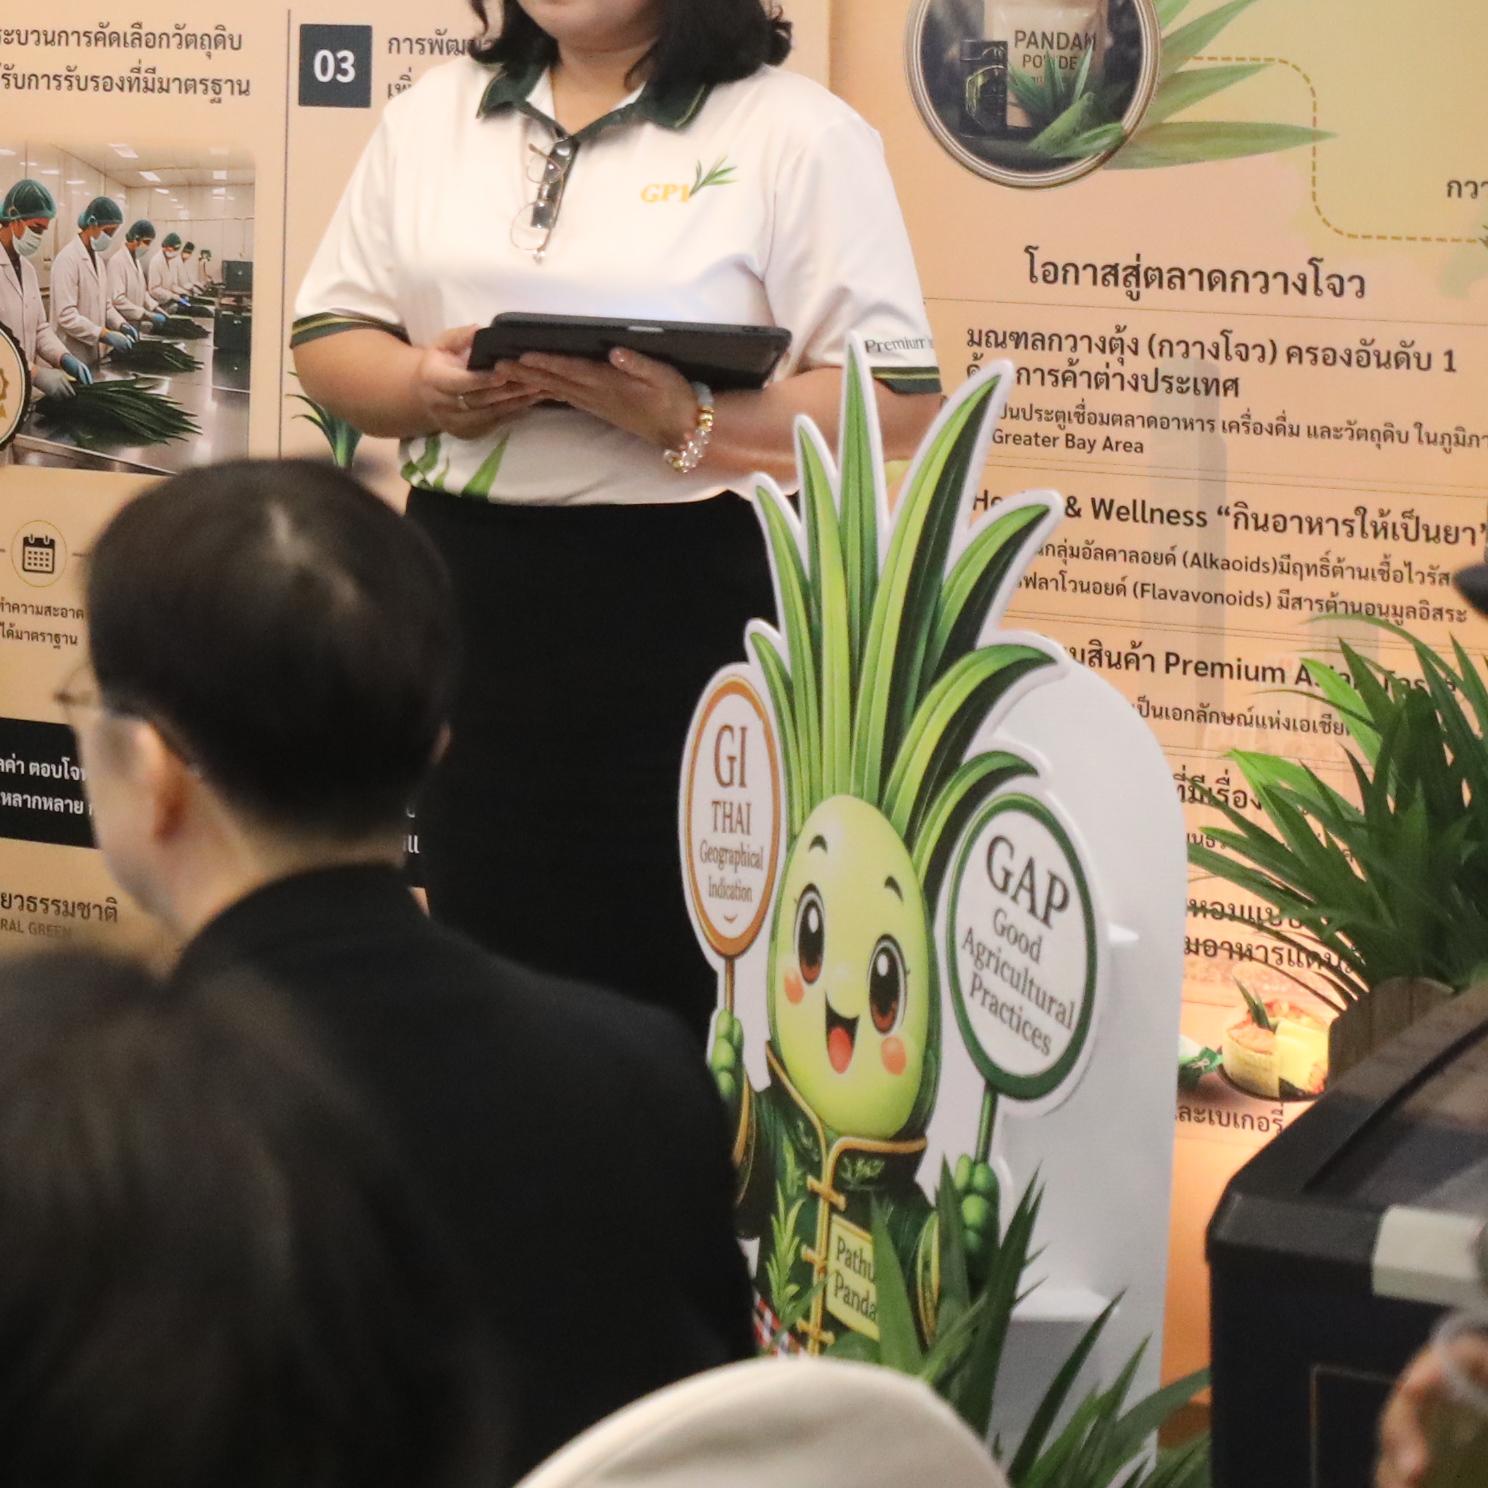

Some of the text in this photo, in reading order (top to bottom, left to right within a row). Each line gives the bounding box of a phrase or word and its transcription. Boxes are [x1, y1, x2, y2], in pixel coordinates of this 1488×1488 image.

[313, 49, 356, 83] 03
[640, 183, 691, 203] GP1
[1023, 244, 1366, 302] โอกาสสู่ตลาดกวางโจว
[966, 324, 1457, 373] มณฑลกวางตุ้ง (กวางโจว) ครองอันดับ 1
[991, 427, 1144, 454] Greater Bay Area
[1221, 407, 1301, 438] เครื่องดื่ม
[1306, 419, 1410, 450] และวัตถุดิบ
[1090, 497, 1208, 528] Wellness
[1017, 571, 1128, 599] ฟลาโวนอยด์
[1132, 580, 1272, 610] (Flavavonoids)
[1164, 651, 1286, 684] Premium
[713, 723, 748, 789] GI
[711, 799, 752, 836] THAI
[699, 839, 764, 874] Geographical
[708, 875, 753, 903] Indication
[986, 833, 1072, 930] GAP
[991, 906, 1044, 966] Good
[960, 925, 1077, 1033] Agricultural
[968, 971, 1053, 1058] Practices
[833, 1269, 877, 1322] Panda
